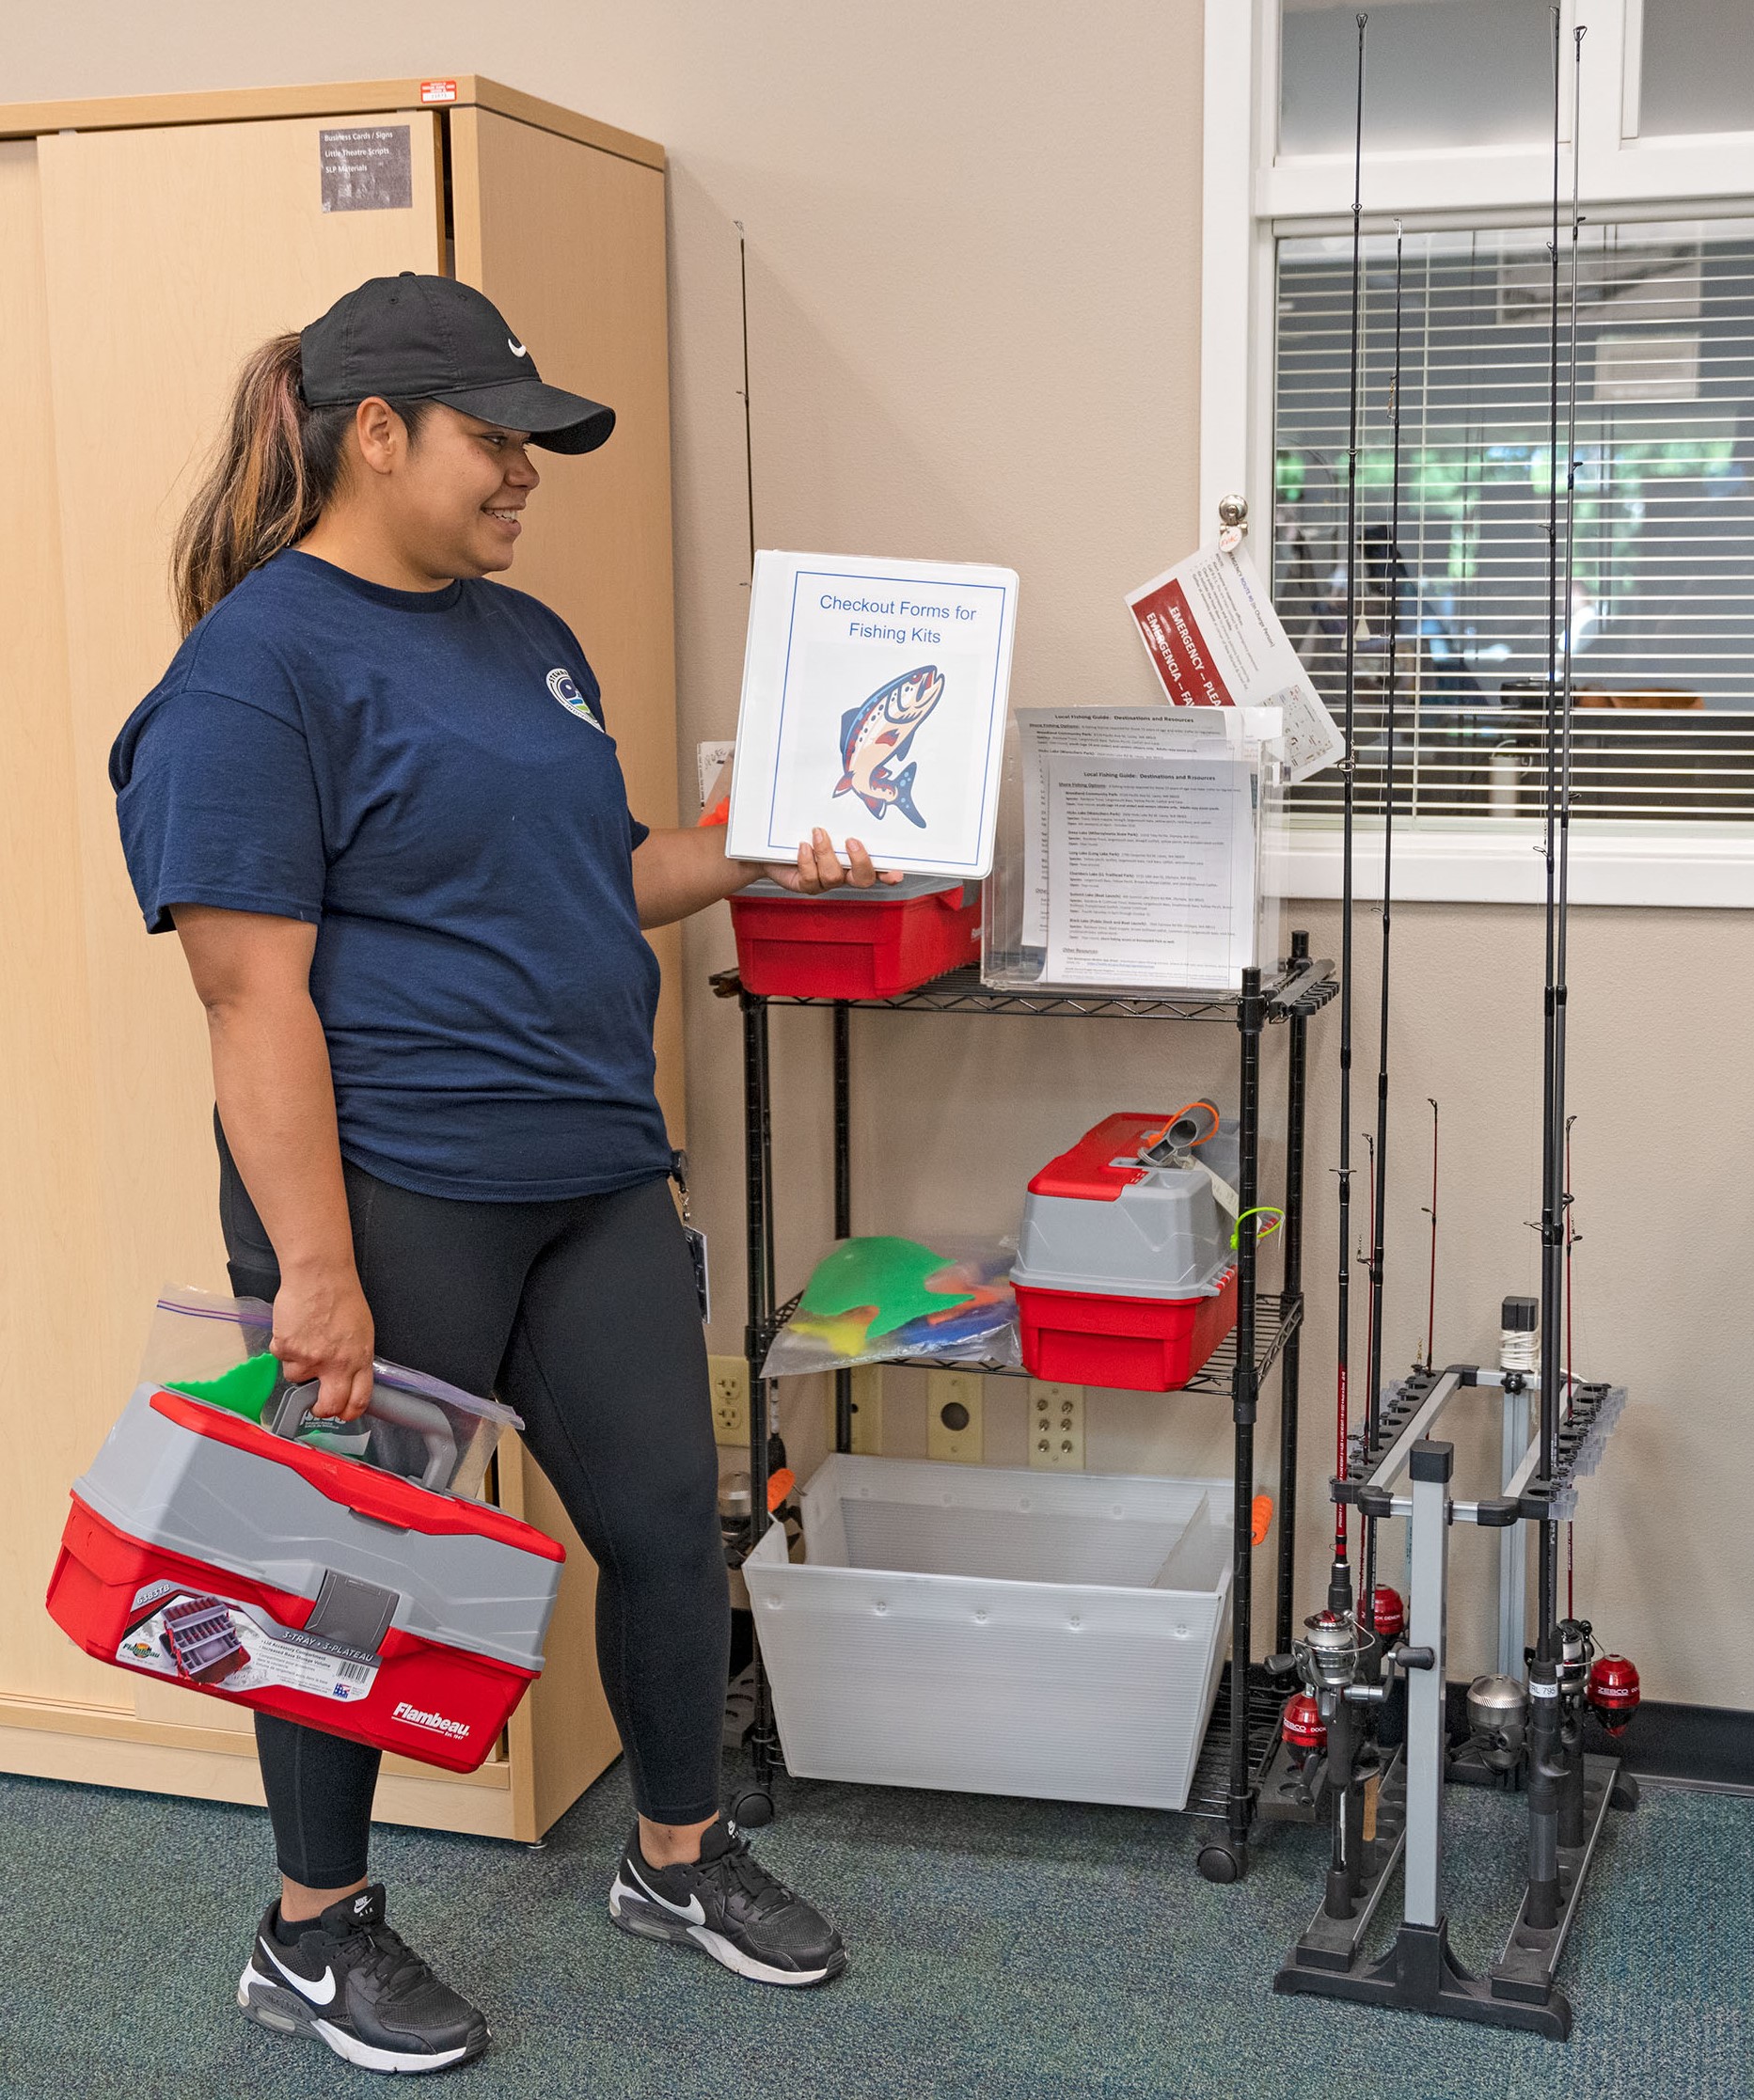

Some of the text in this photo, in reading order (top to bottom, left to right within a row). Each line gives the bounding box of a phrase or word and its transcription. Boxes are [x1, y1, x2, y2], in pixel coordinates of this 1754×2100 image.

[324, 134, 352, 142] Business
[353, 132, 371, 140] Cards
[375, 132, 393, 140] Signs
[341, 149, 367, 157] Theatre
[368, 148, 389, 156] Scripts
[325, 164, 368, 174] SLP Materials
[820, 594, 977, 621] Checkout Forms for
[848, 623, 941, 644] Fishing Kits
[1146, 612, 1181, 682] EMERGENCIA
[1170, 606, 1205, 671] EMERGENCY
[1204, 681, 1222, 706] PLEA
[282, 1631, 374, 1664] 3-TRAY 3-PLATEAU
[1542, 1684, 1556, 1694] 795
[1598, 1685, 1629, 1697] ZEBCO
